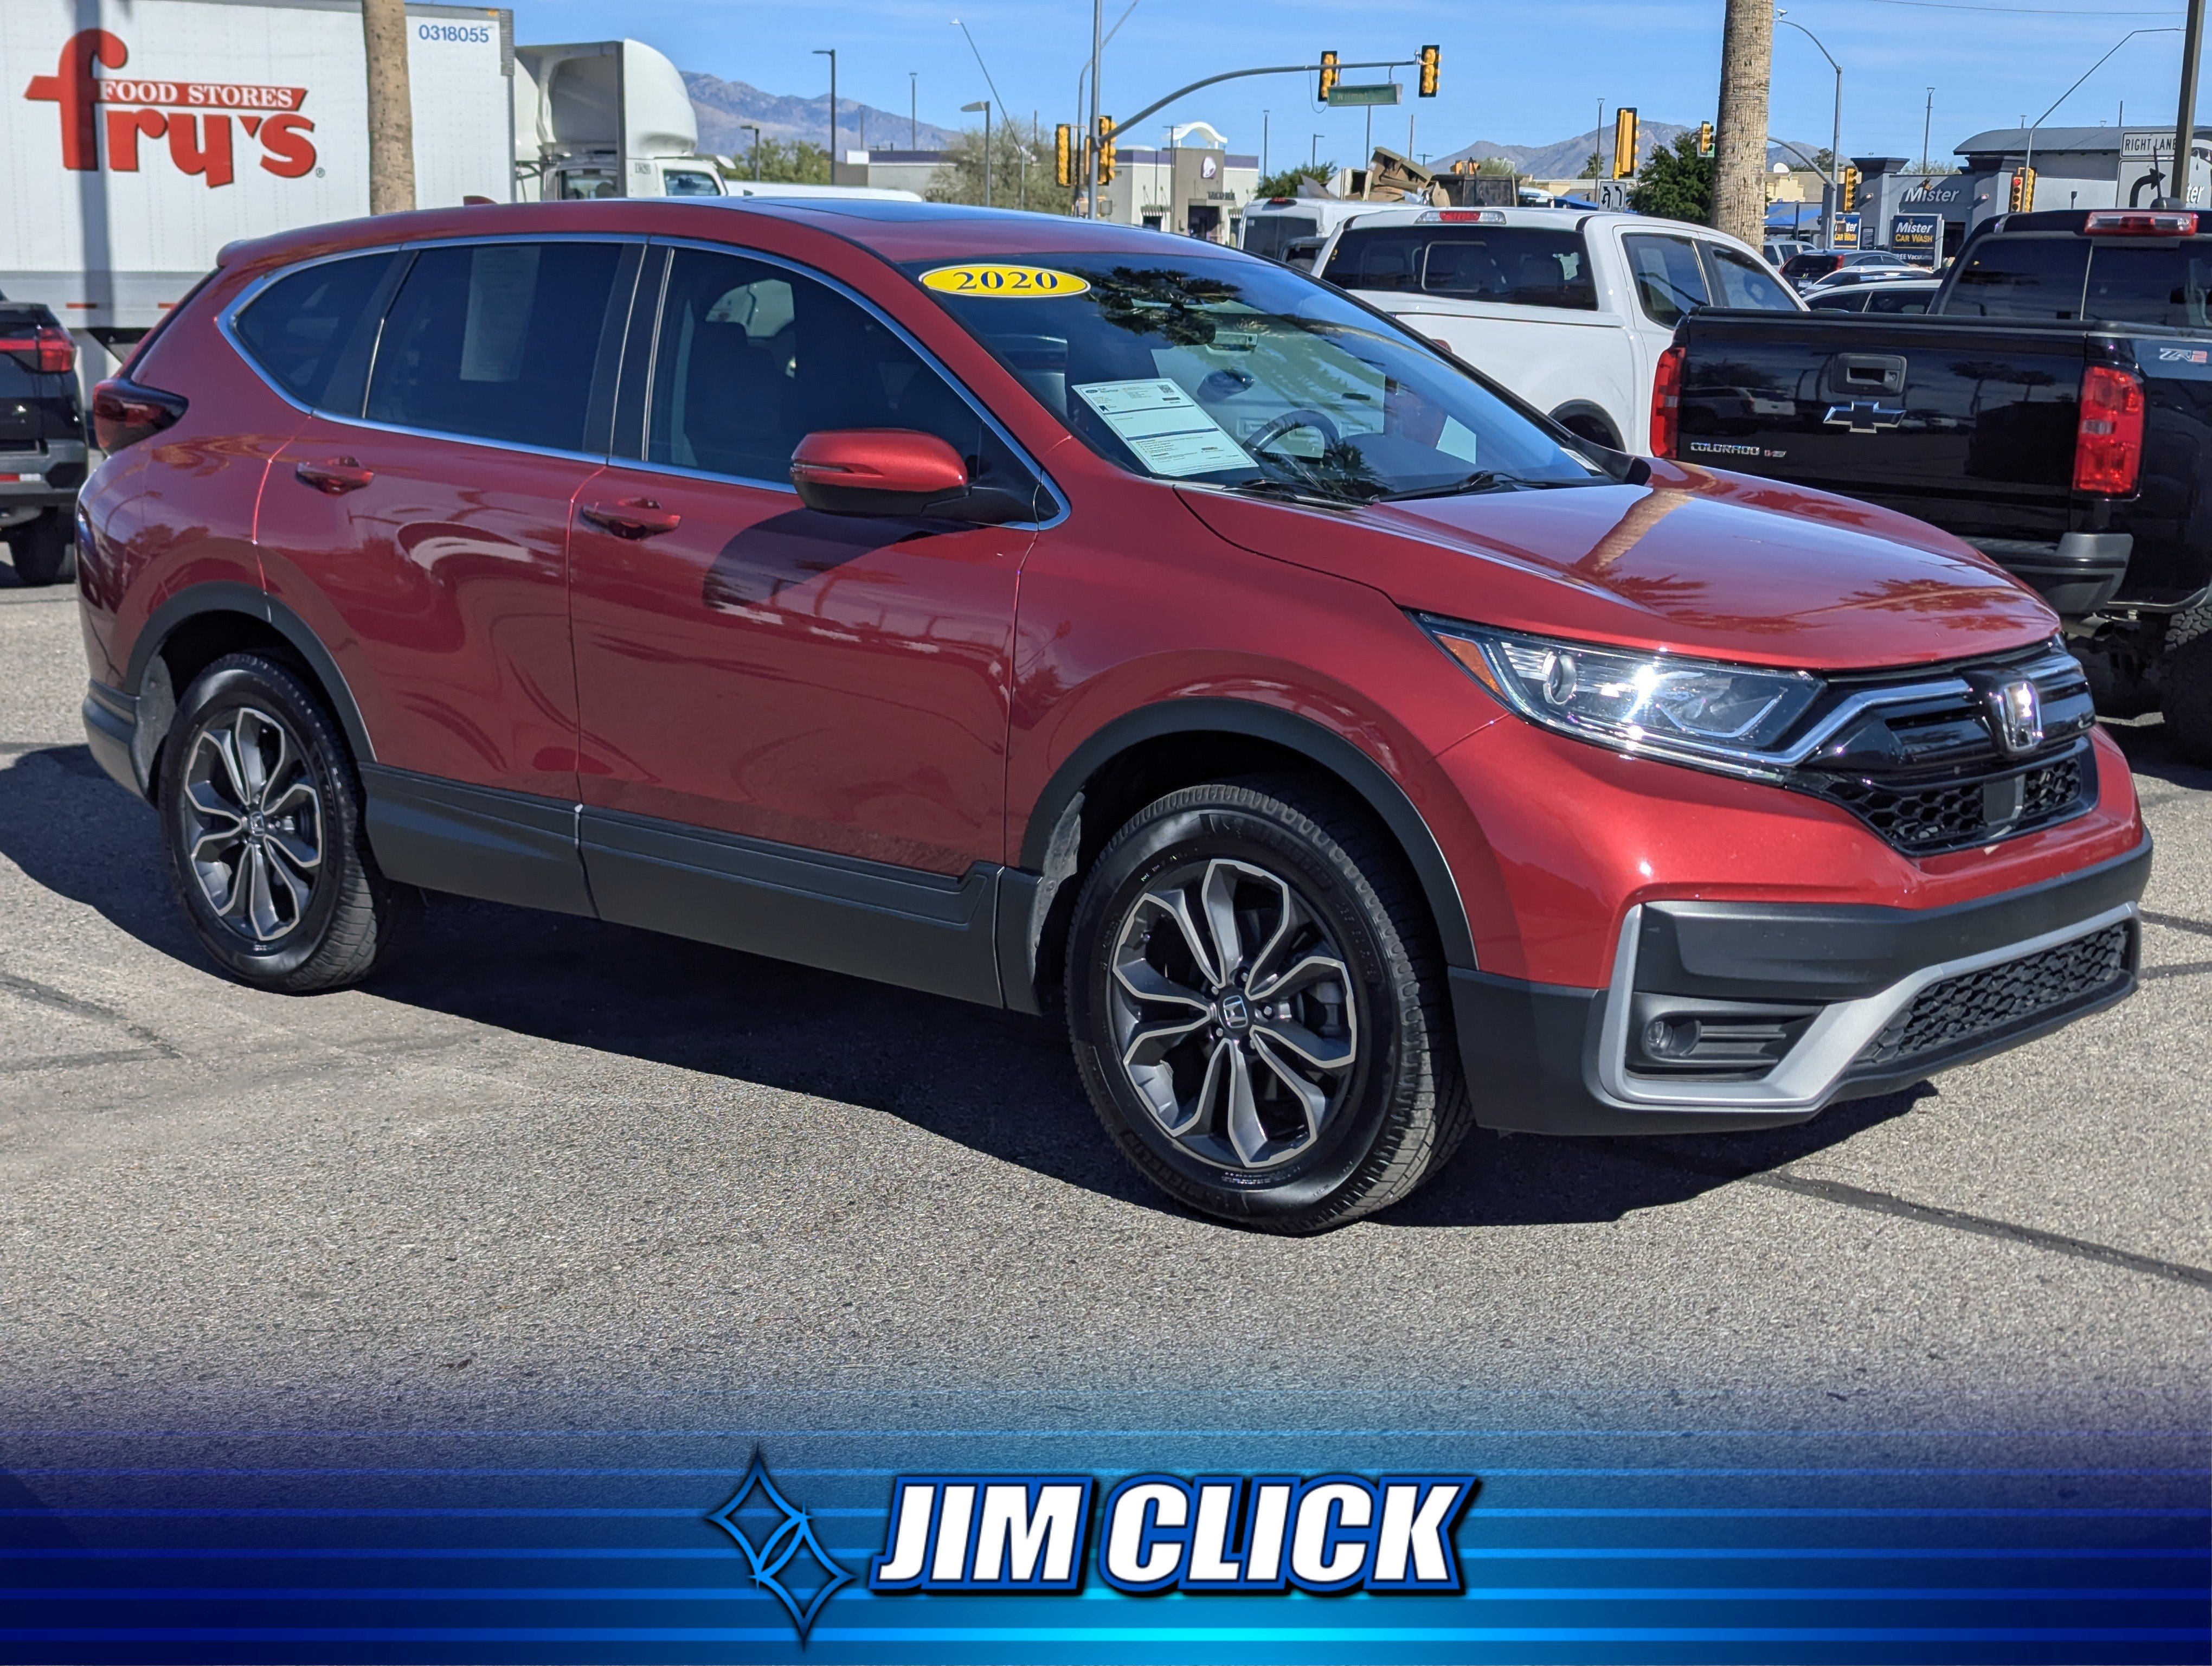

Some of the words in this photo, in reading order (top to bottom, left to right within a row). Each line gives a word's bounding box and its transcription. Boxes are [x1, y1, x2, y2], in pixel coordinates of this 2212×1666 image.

[418, 24, 489, 43] 0318055
[101, 81, 178, 103] FOOD
[188, 84, 293, 107] STORES
[1337, 92, 1368, 101] Wilmot
[2125, 138, 2152, 151] RIGHT
[1905, 187, 1960, 202] Mister
[2185, 184, 2205, 203] ter
[1896, 221, 1933, 234] Mister
[1834, 233, 1844, 241] CAR
[1895, 234, 1910, 242] CAR
[1912, 234, 1934, 243] WASH
[953, 271, 1058, 290] 2020
[2159, 348, 2207, 363] ZR2
[1690, 442, 1760, 456] COLORADO
